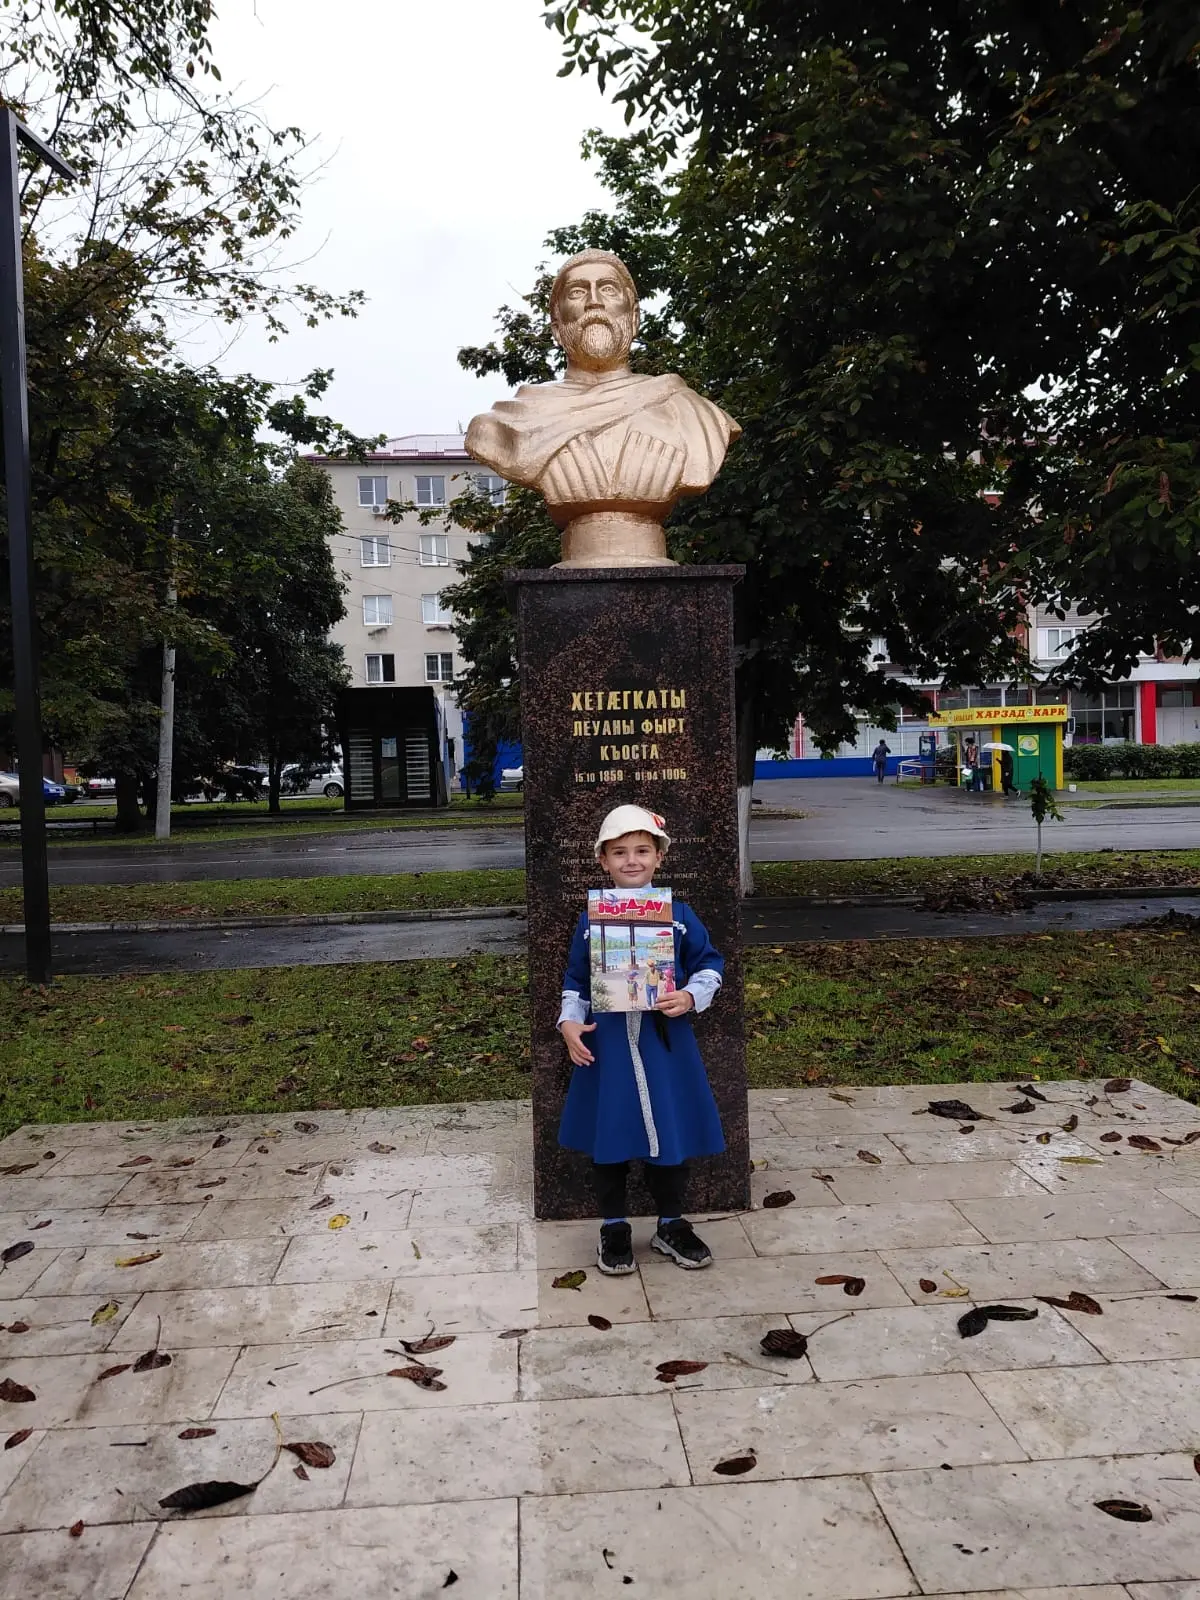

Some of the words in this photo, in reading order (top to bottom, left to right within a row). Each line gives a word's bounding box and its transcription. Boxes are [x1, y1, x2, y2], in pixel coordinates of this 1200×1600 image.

[571, 689, 686, 711] ХЕТÆГКАТЫ
[975, 709, 1025, 719] ХАРЗАД
[1033, 707, 1065, 717] КАРК
[573, 719, 635, 737] ЛЕУАНЫ
[641, 718, 685, 735] ФЫРТ
[600, 744, 659, 761] КЪОСТА
